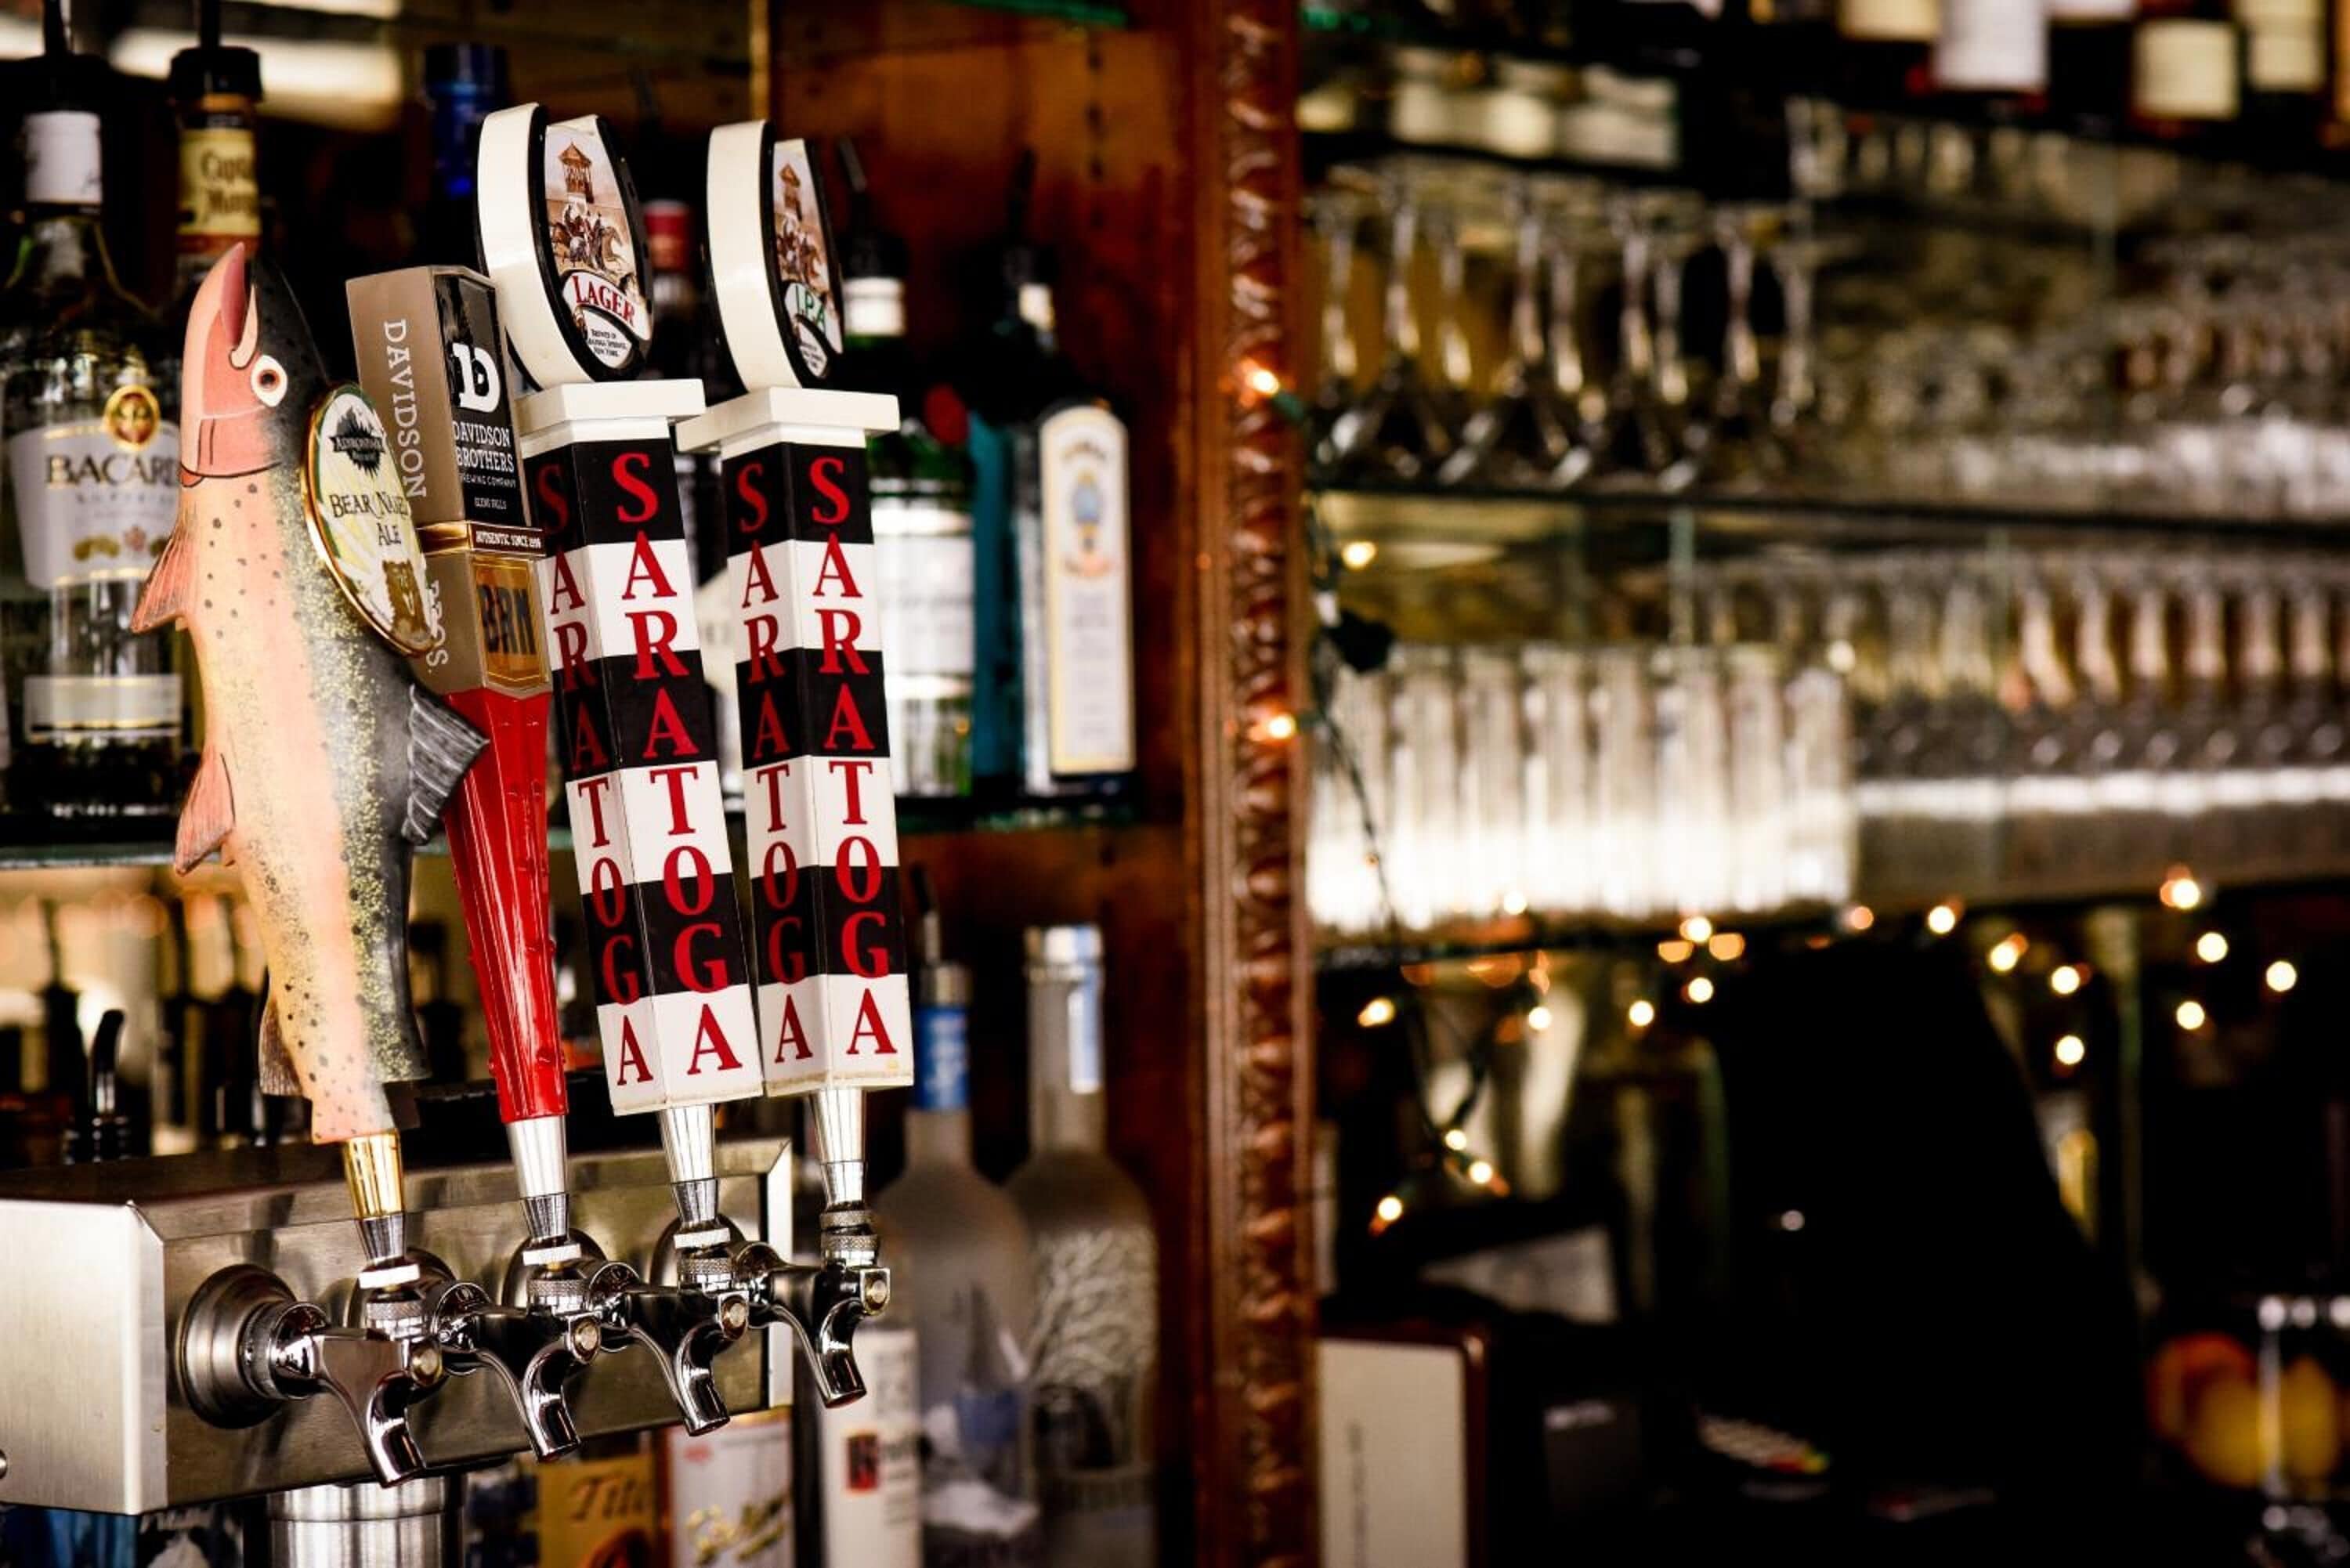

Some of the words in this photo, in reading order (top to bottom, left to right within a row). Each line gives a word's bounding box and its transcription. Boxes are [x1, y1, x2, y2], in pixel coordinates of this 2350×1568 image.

[572, 275, 636, 328] LAGER
[384, 319, 427, 499] DAVIDSON
[452, 421, 511, 447] DAVIDSON
[455, 446, 515, 473] BROTHERS
[329, 493, 379, 519] BEAR
[377, 522, 403, 546] ALE
[538, 464, 653, 1086] SARATOGA
[611, 452, 742, 1075] SARATOGA
[736, 461, 813, 1063] SARATOGA
[808, 456, 898, 1056] SARATOGA
